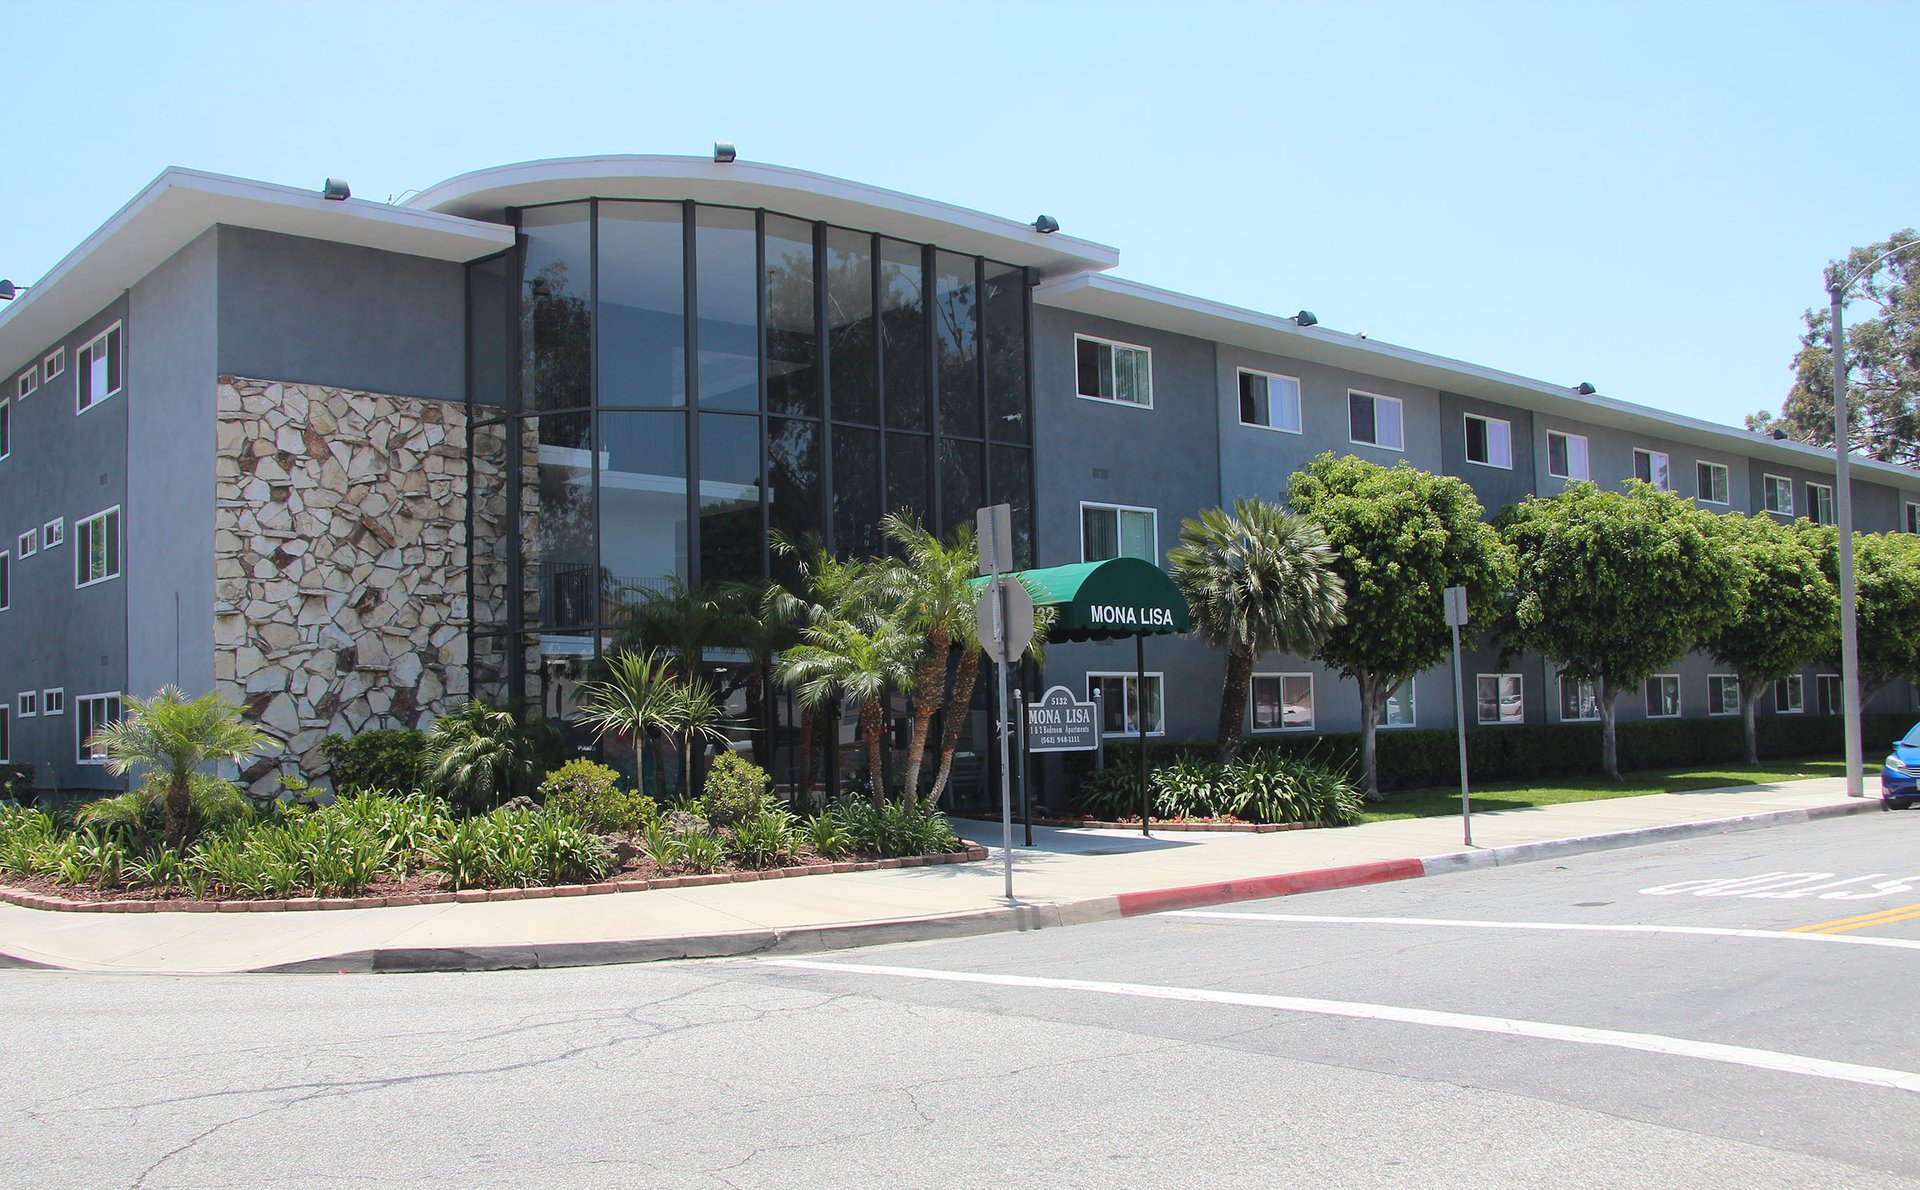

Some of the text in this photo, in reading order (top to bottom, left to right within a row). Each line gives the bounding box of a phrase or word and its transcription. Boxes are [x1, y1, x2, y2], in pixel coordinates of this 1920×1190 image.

[1036, 606, 1056, 624] 32
[1090, 605, 1174, 626] MONA LISA
[1051, 697, 1067, 705] 5132
[1028, 708, 1090, 724] MONA LISA
[1043, 726, 1062, 734] Bedroom
[1065, 726, 1089, 734] Apartments
